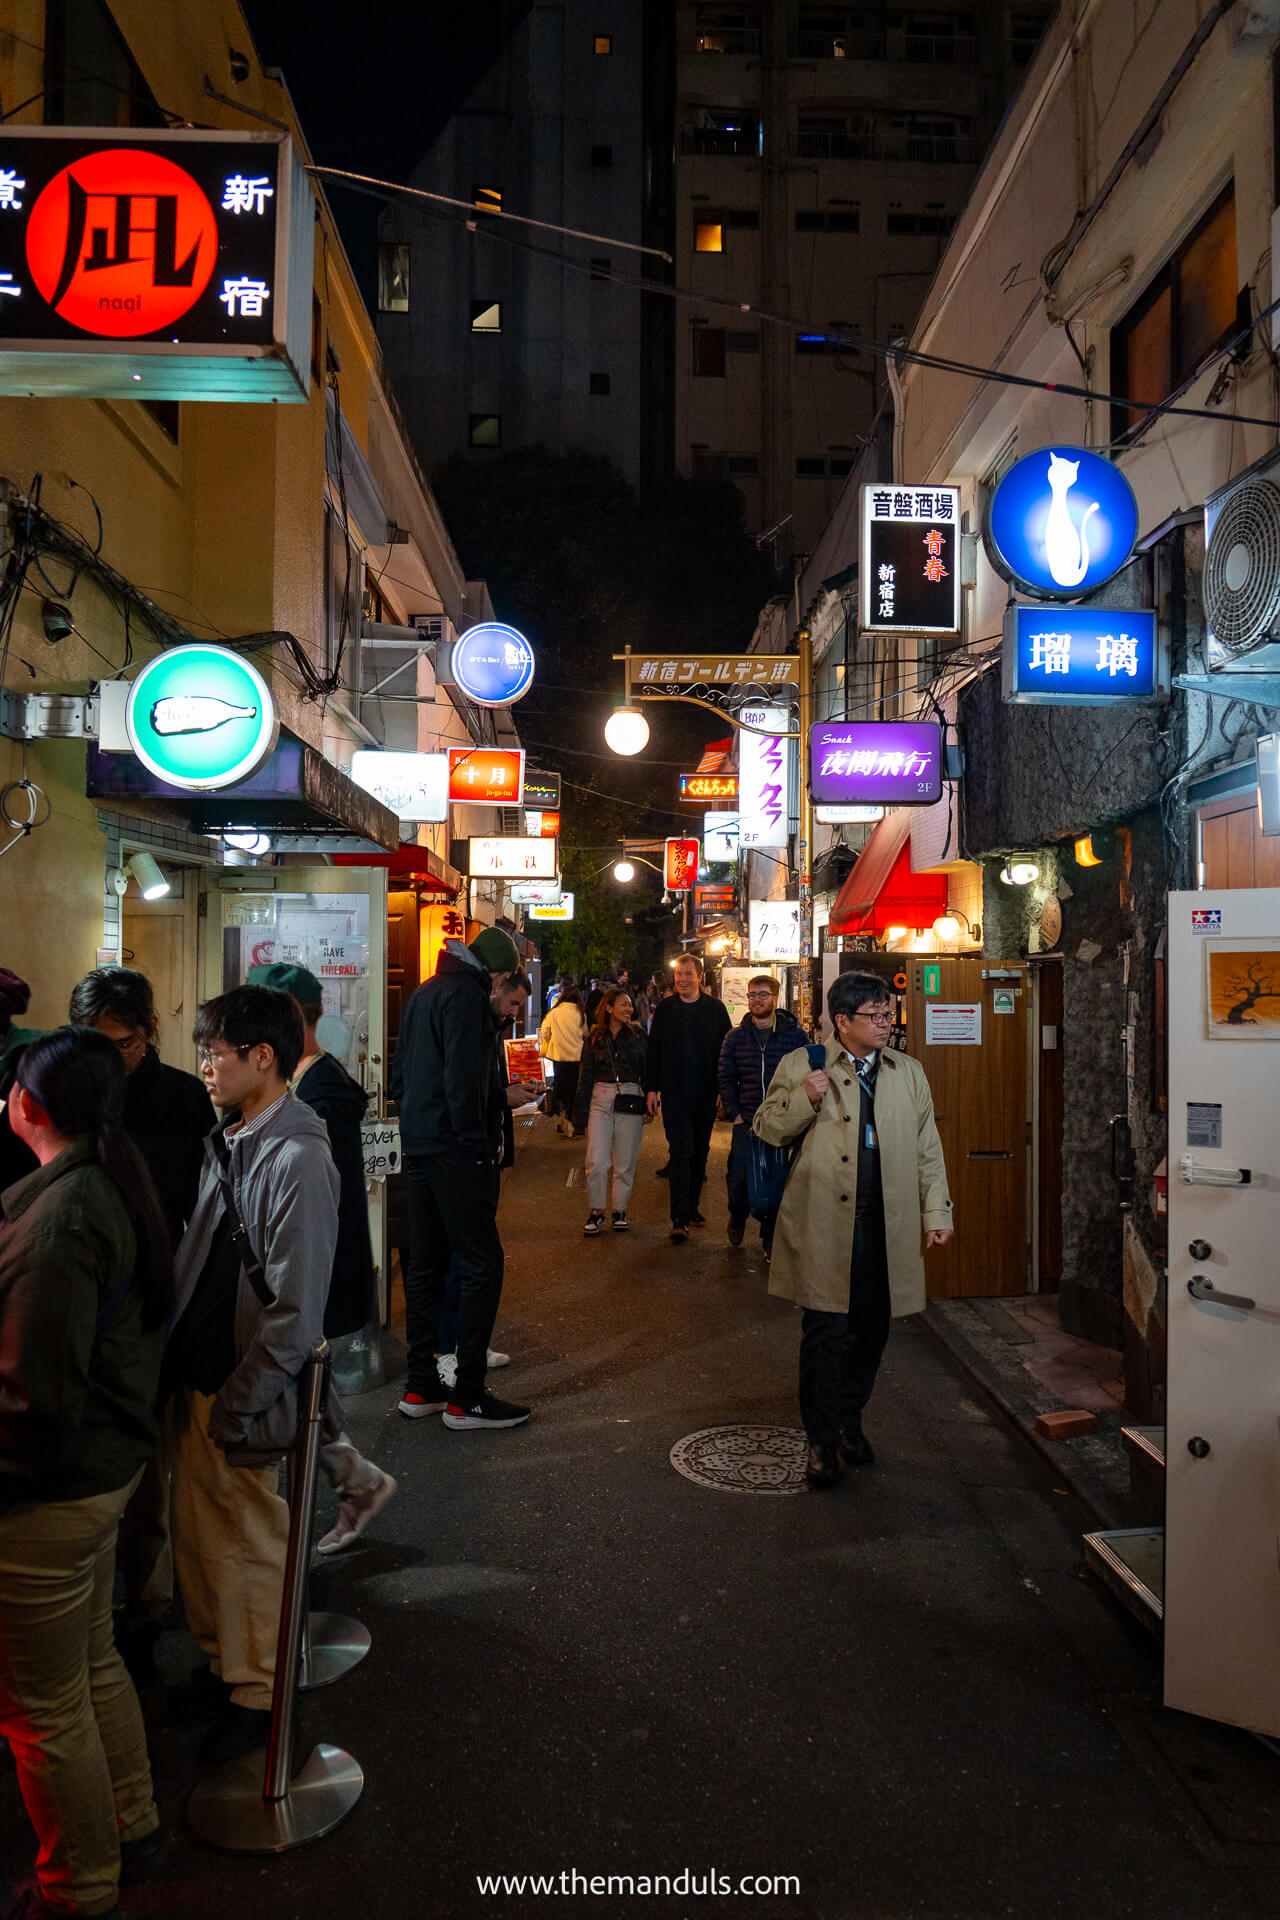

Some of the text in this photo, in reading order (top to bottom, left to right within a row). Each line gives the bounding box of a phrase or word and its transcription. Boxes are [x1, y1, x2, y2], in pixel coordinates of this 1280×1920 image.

[219, 174, 273, 317] 新宿
[99, 295, 142, 314] nagi
[872, 491, 953, 519] 音盤酒場
[922, 530, 948, 583] 青春
[877, 563, 896, 618] 新宿店
[1028, 632, 1139, 677] 瑠璃
[638, 661, 792, 681] 新宿ゴールデン街
[744, 712, 766, 724] BAR
[820, 734, 853, 745] Snack
[820, 750, 932, 777] 夜間飛行
[463, 766, 506, 785] 十月
[758, 735, 782, 830] クラクラ
[917, 782, 933, 793] 2F
[744, 833, 759, 842] 2F
[323, 947, 344, 958] HAVE
[321, 965, 358, 976] FIREBALL
